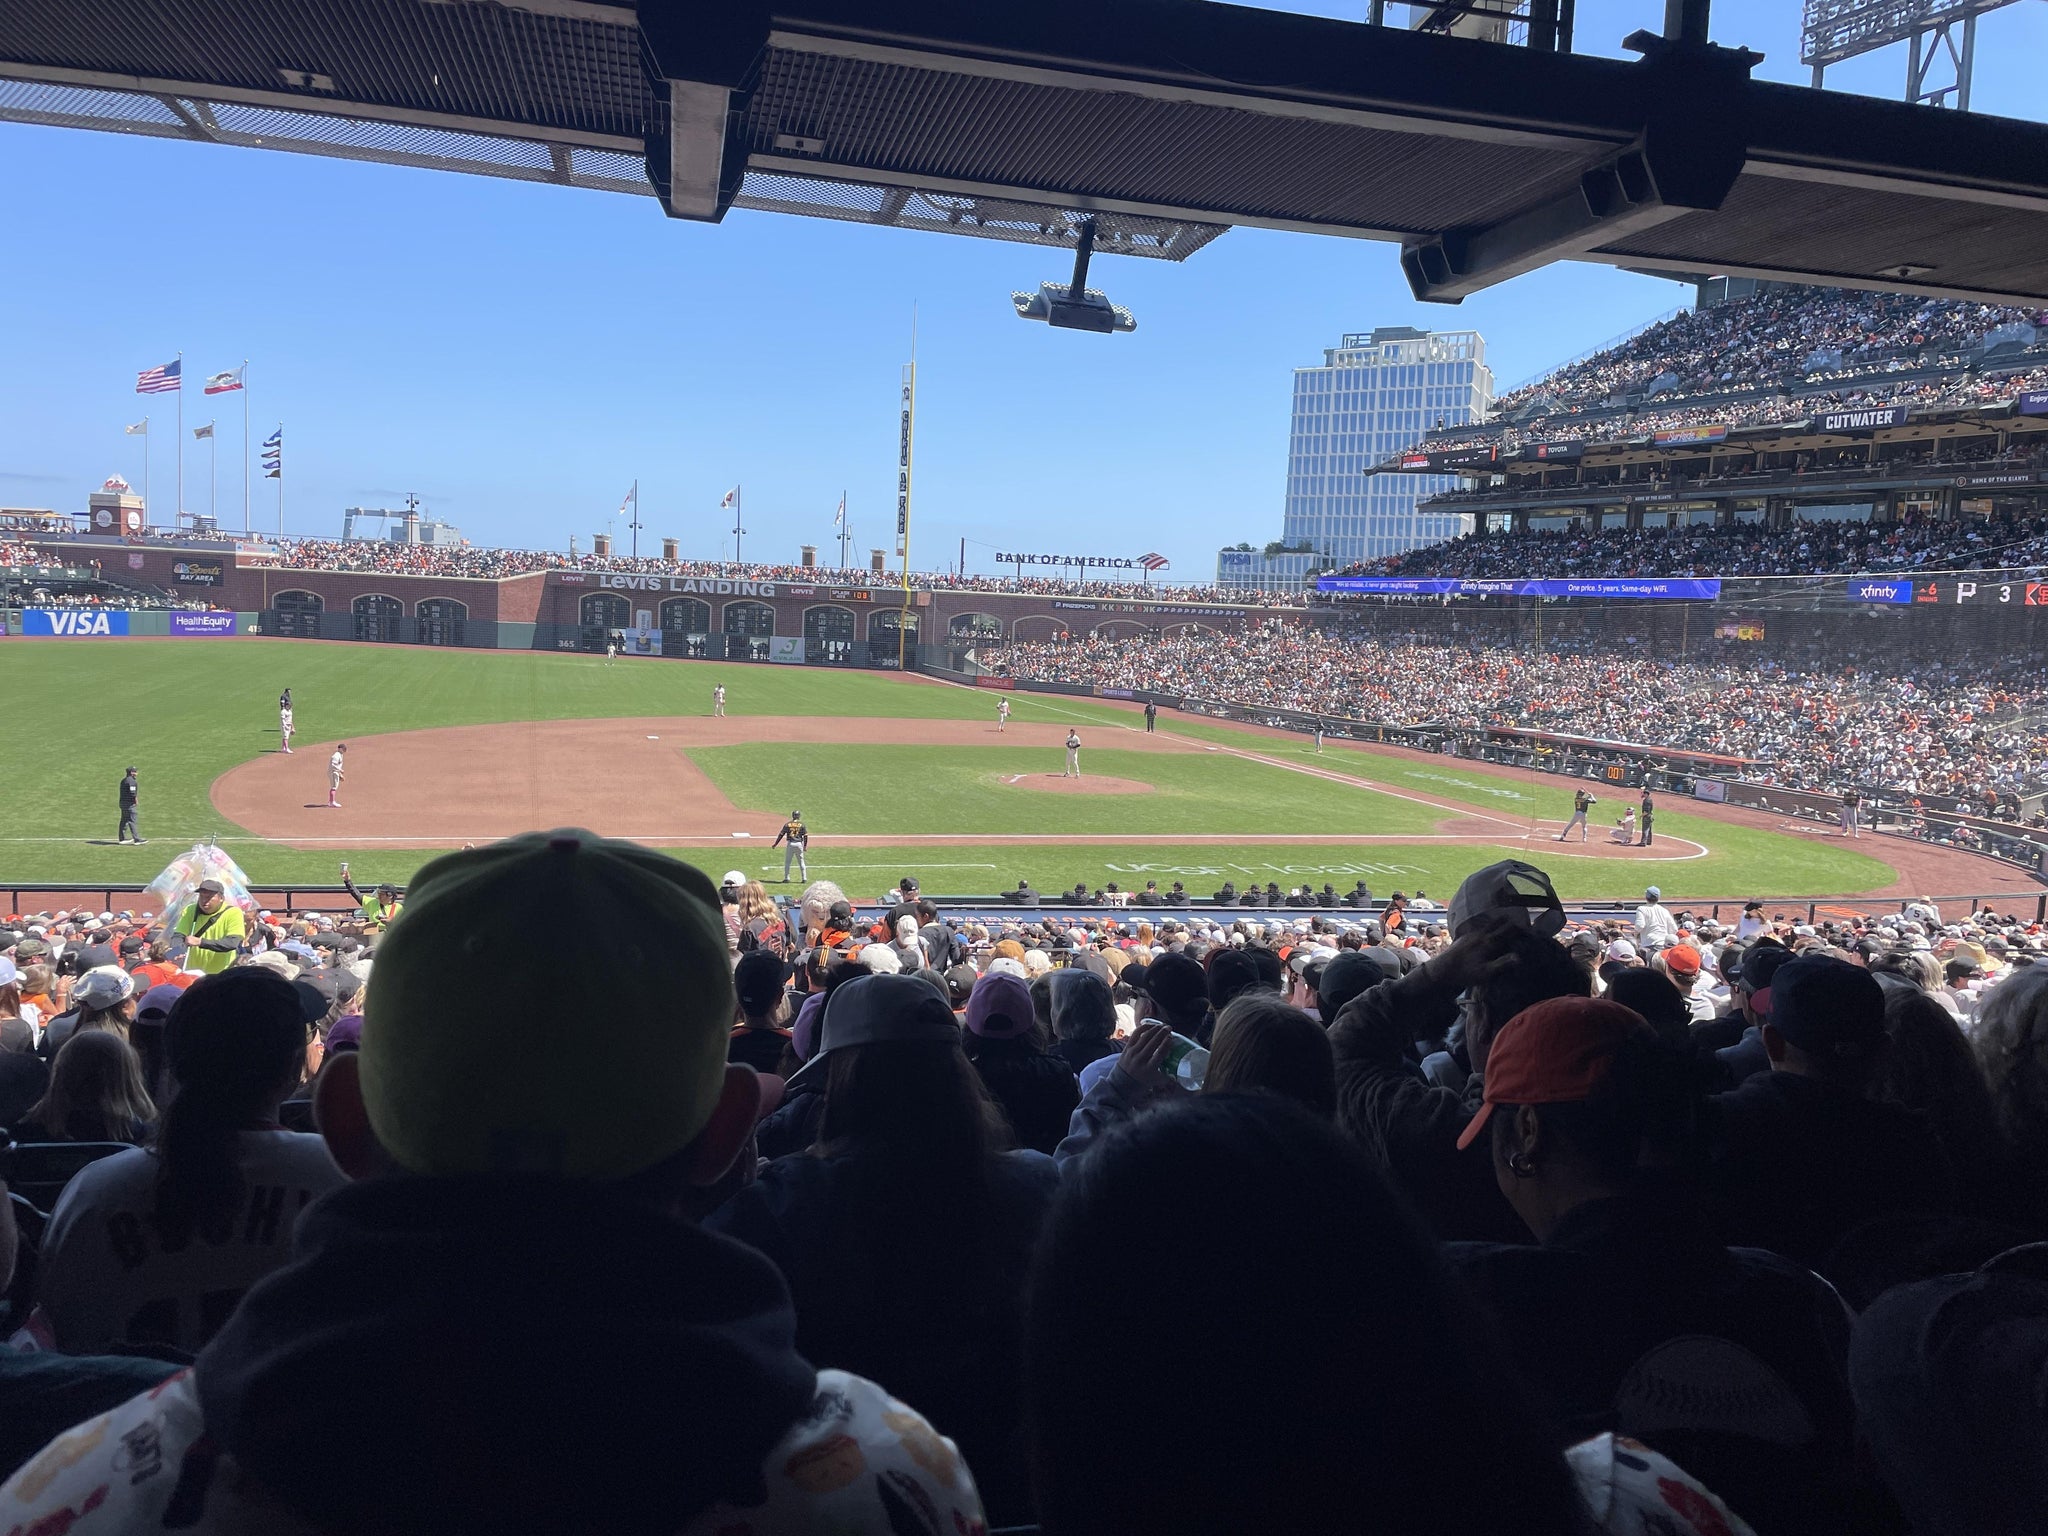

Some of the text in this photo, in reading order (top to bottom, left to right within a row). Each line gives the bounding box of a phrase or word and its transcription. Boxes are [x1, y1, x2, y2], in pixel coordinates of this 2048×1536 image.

[1826, 411, 1893, 429] CUTWATER
[1548, 446, 1568, 454] TOYOTA
[995, 553, 1132, 568] BANK OF AMERICA
[1221, 553, 1250, 565] VISA
[188, 563, 221, 575] Sports
[670, 578, 775, 597] LANDING
[1460, 582, 1513, 592] xfinity Imagine That
[1580, 584, 1597, 593] price.
[1621, 584, 1651, 594] Same-day
[1860, 584, 1897, 599] xfinity
[853, 591, 867, 599] 108
[1928, 583, 1937, 595] 6
[1999, 586, 2011, 602] 3
[44, 612, 110, 635] VISA
[176, 617, 232, 627] HealthEquity
[248, 625, 262, 633] 415
[558, 640, 575, 648] 365
[882, 659, 899, 667] 309
[982, 678, 1009, 686] ORACLE
[1608, 766, 1625, 780] 007
[1913, 910, 1920, 918] 5
